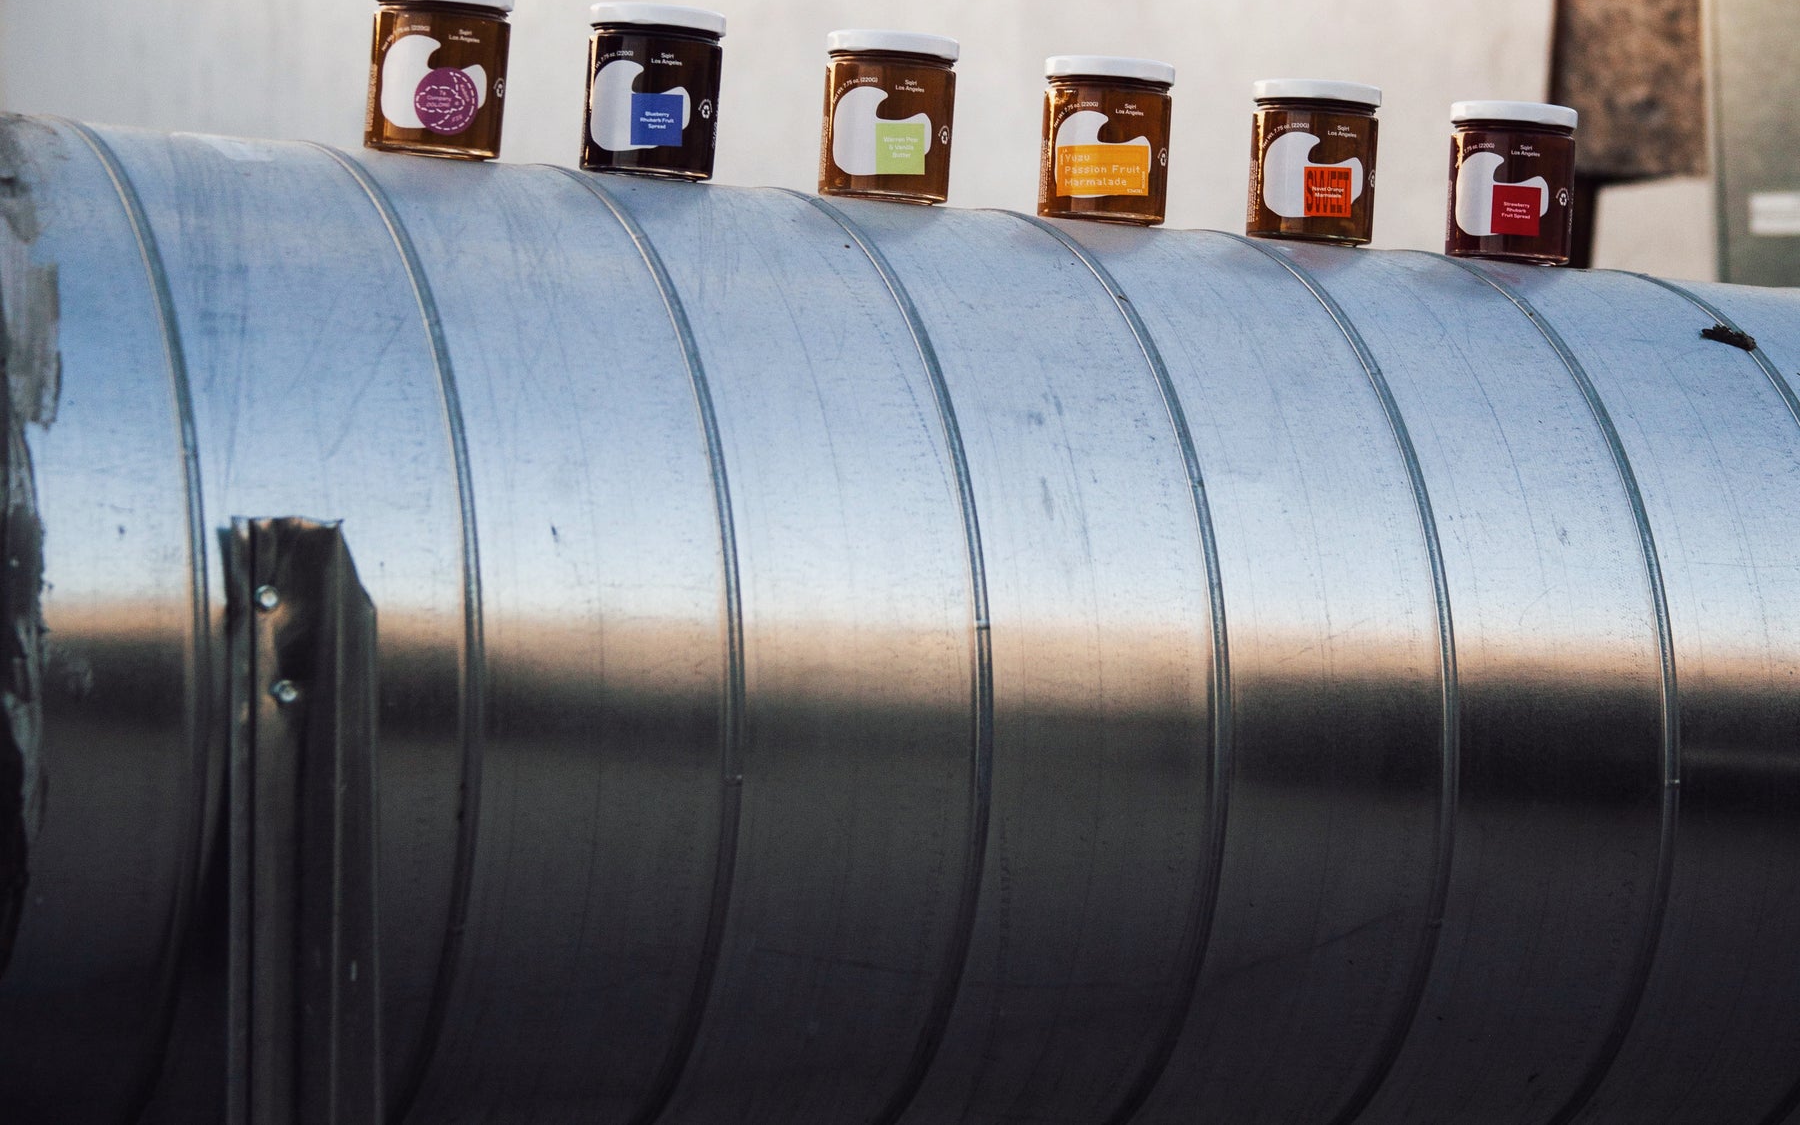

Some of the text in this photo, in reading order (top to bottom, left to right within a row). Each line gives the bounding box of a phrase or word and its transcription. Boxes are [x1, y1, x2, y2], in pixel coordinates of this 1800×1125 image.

[459, 35, 480, 44] Angeles
[843, 79, 853, 88] 7.75
[905, 85, 925, 93] Angeles
[1064, 104, 1074, 113] 7.75
[1125, 109, 1144, 117] Angeles
[1273, 124, 1284, 133] 7.75
[1064, 154, 1090, 162] Yuzu
[1064, 164, 1141, 174] Passion Fruit
[1064, 178, 1127, 187] Marmalade
[1306, 170, 1349, 213] SWEET
[1503, 201, 1530, 209] Strawberry
